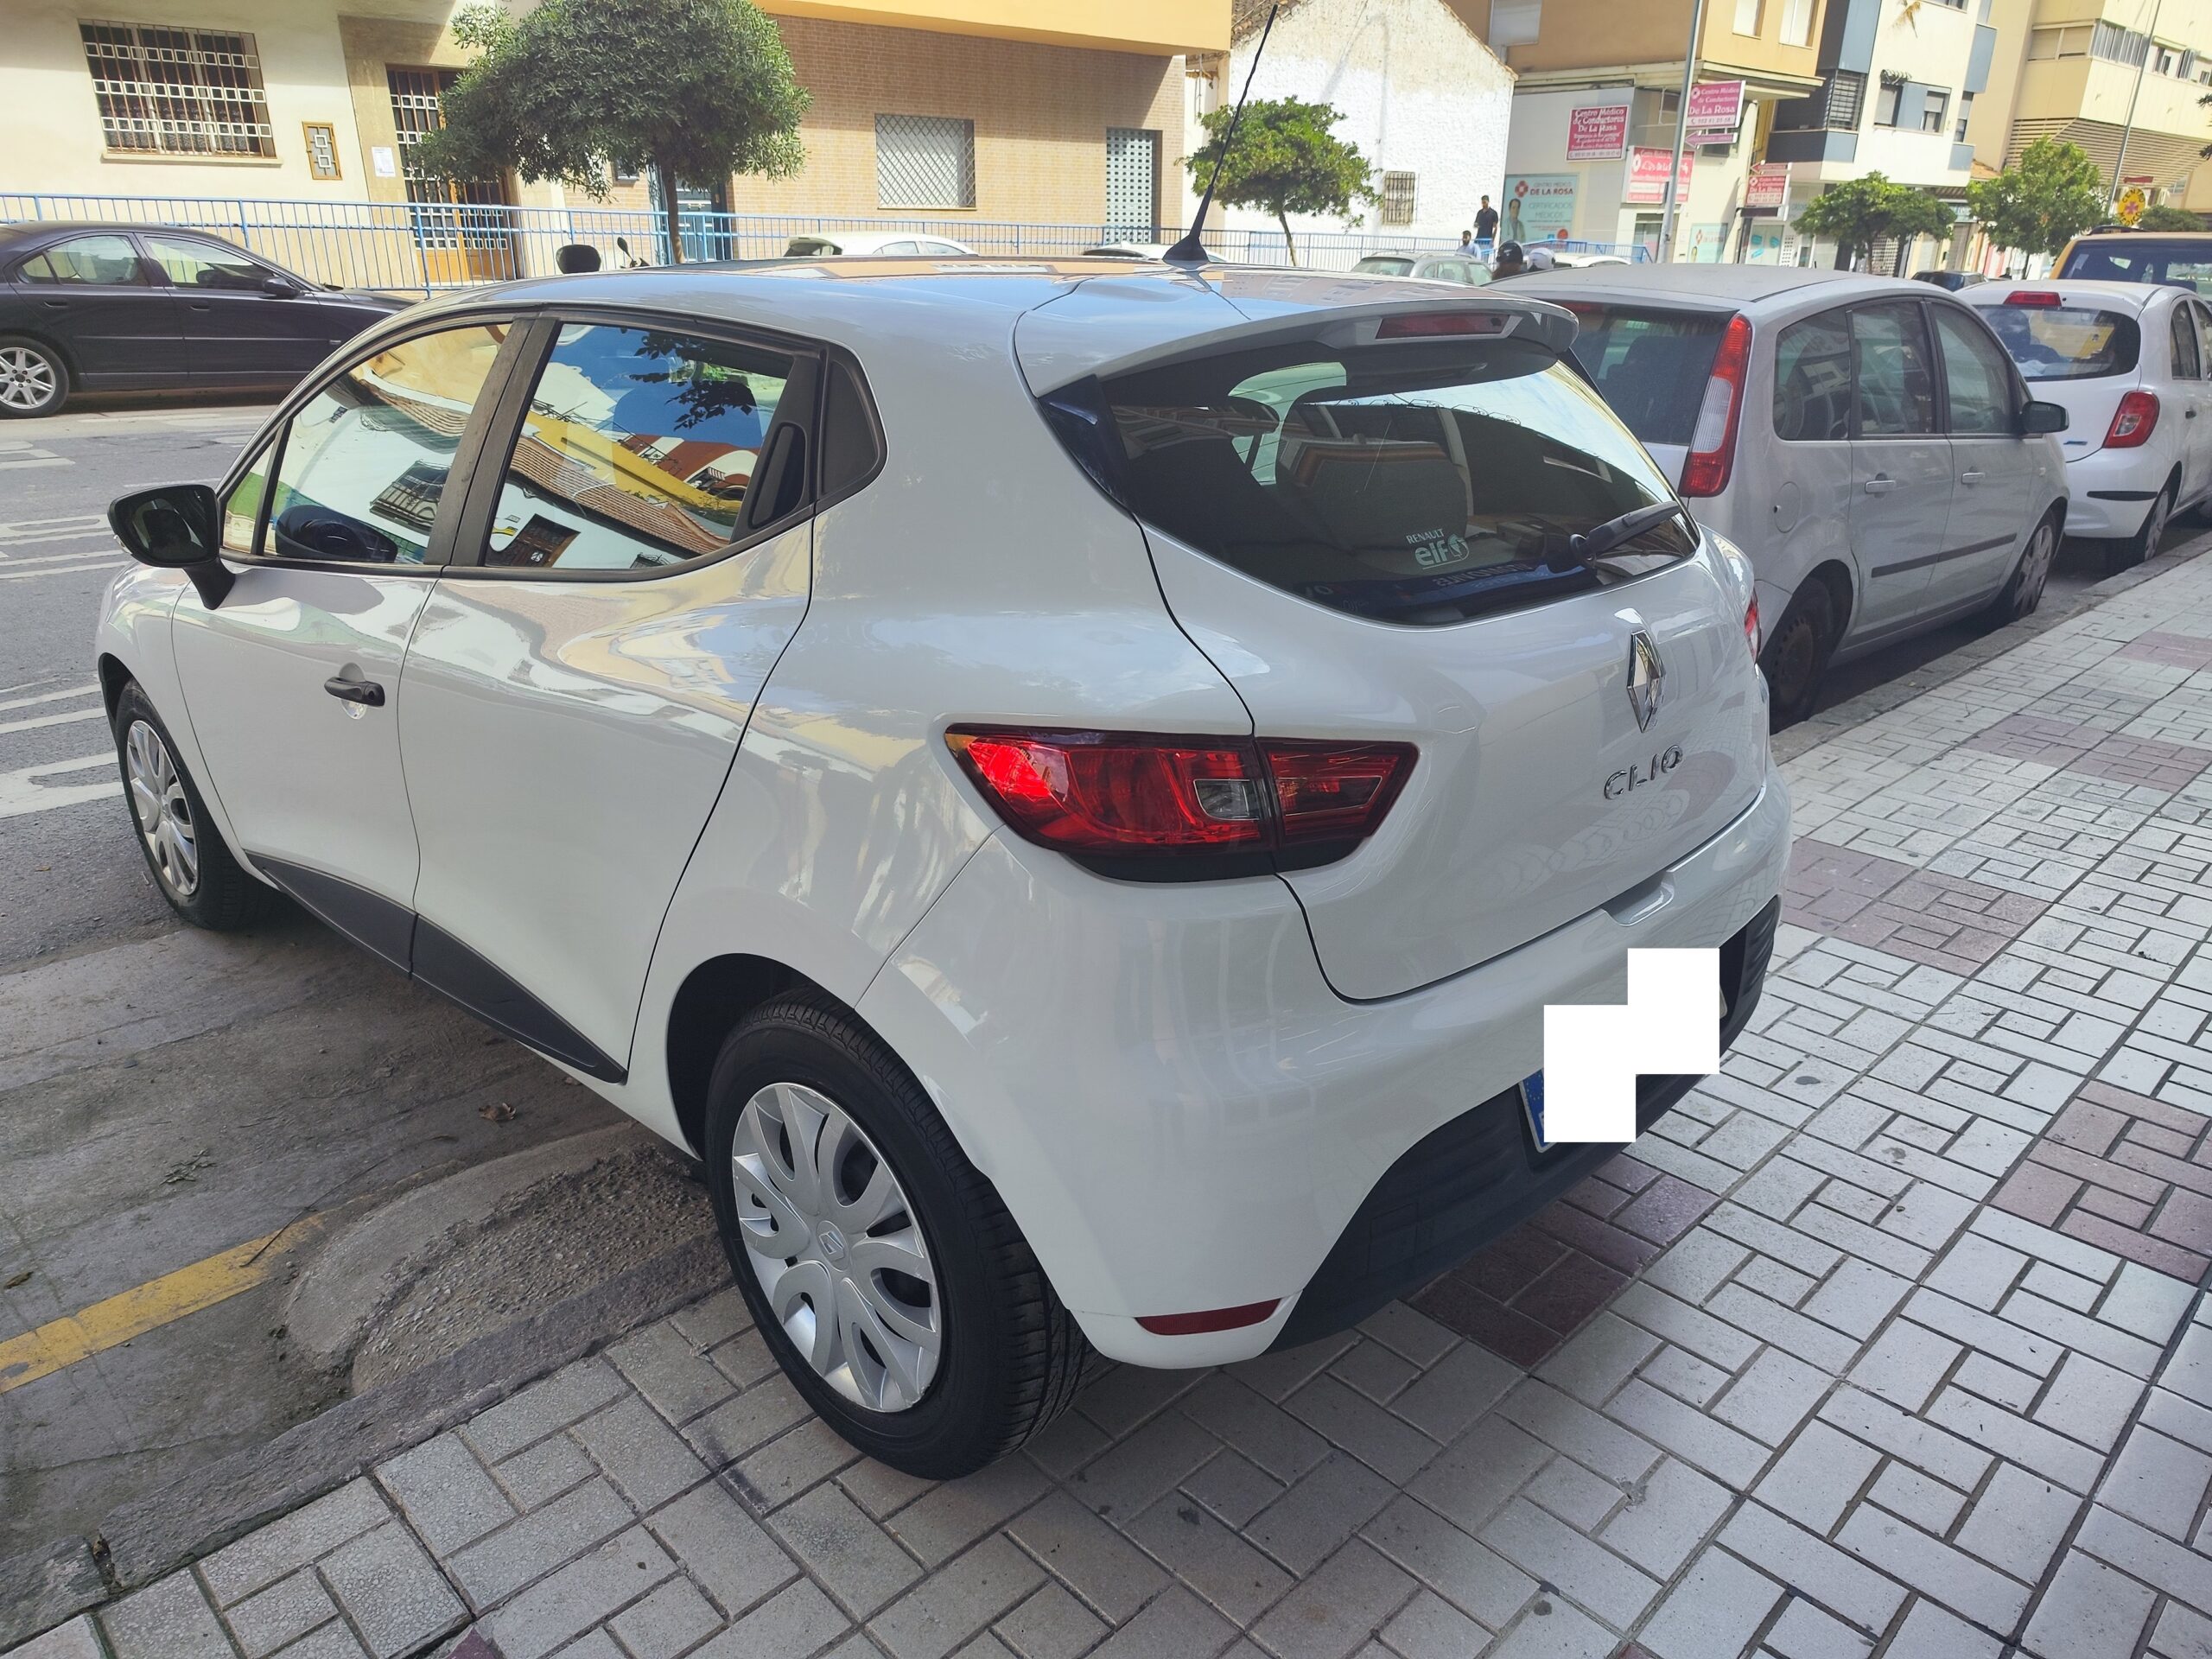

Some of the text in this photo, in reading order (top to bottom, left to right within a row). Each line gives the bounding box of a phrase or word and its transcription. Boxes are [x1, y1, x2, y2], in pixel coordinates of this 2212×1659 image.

[1599, 108, 1624, 117] Médico
[1689, 105, 1736, 115] De La Rosa
[1406, 528, 1445, 544] RENAULT
[1414, 539, 1450, 567] elf
[1604, 745, 1683, 800] CLIO
